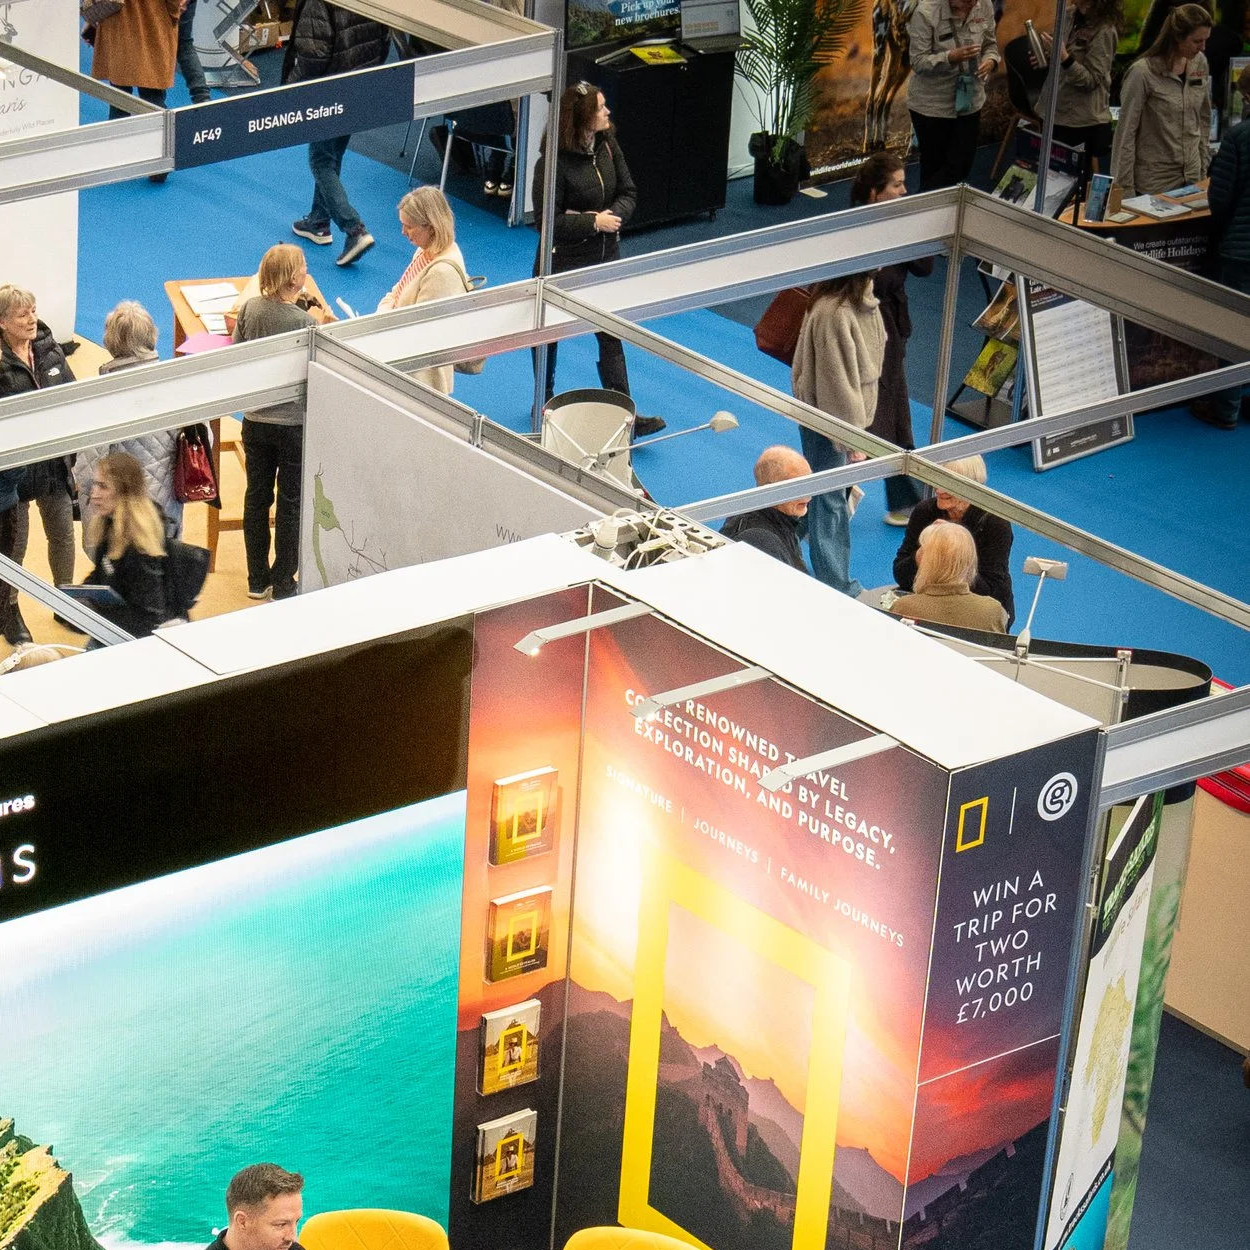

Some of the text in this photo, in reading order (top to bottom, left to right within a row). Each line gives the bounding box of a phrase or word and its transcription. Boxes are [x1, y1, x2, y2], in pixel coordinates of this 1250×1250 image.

[615, 16, 633, 26] new
[621, 0, 639, 13] Pick
[641, 1, 654, 12] up
[193, 102, 344, 145] AF49 BUSANGA Safaris
[1133, 242, 1145, 250] We
[1145, 240, 1166, 249] create
[1167, 245, 1206, 256] Holidays
[685, 697, 849, 802] RENOWNED TAVEL
[634, 716, 882, 871] EXPLORATION, AND PURPOSE.
[728, 746, 793, 795] SHAPD
[798, 781, 821, 810] BY
[825, 801, 896, 855] LEGACY,
[605, 765, 904, 948] SIGNATURE JOURNEYS FAMILY JOURNEYS
[973, 869, 1044, 908] WIN A
[953, 893, 1058, 943] TRIP FOR
[975, 929, 1029, 963] TWO
[955, 951, 1042, 997] WORTH
[956, 981, 1034, 1025] £7,000
